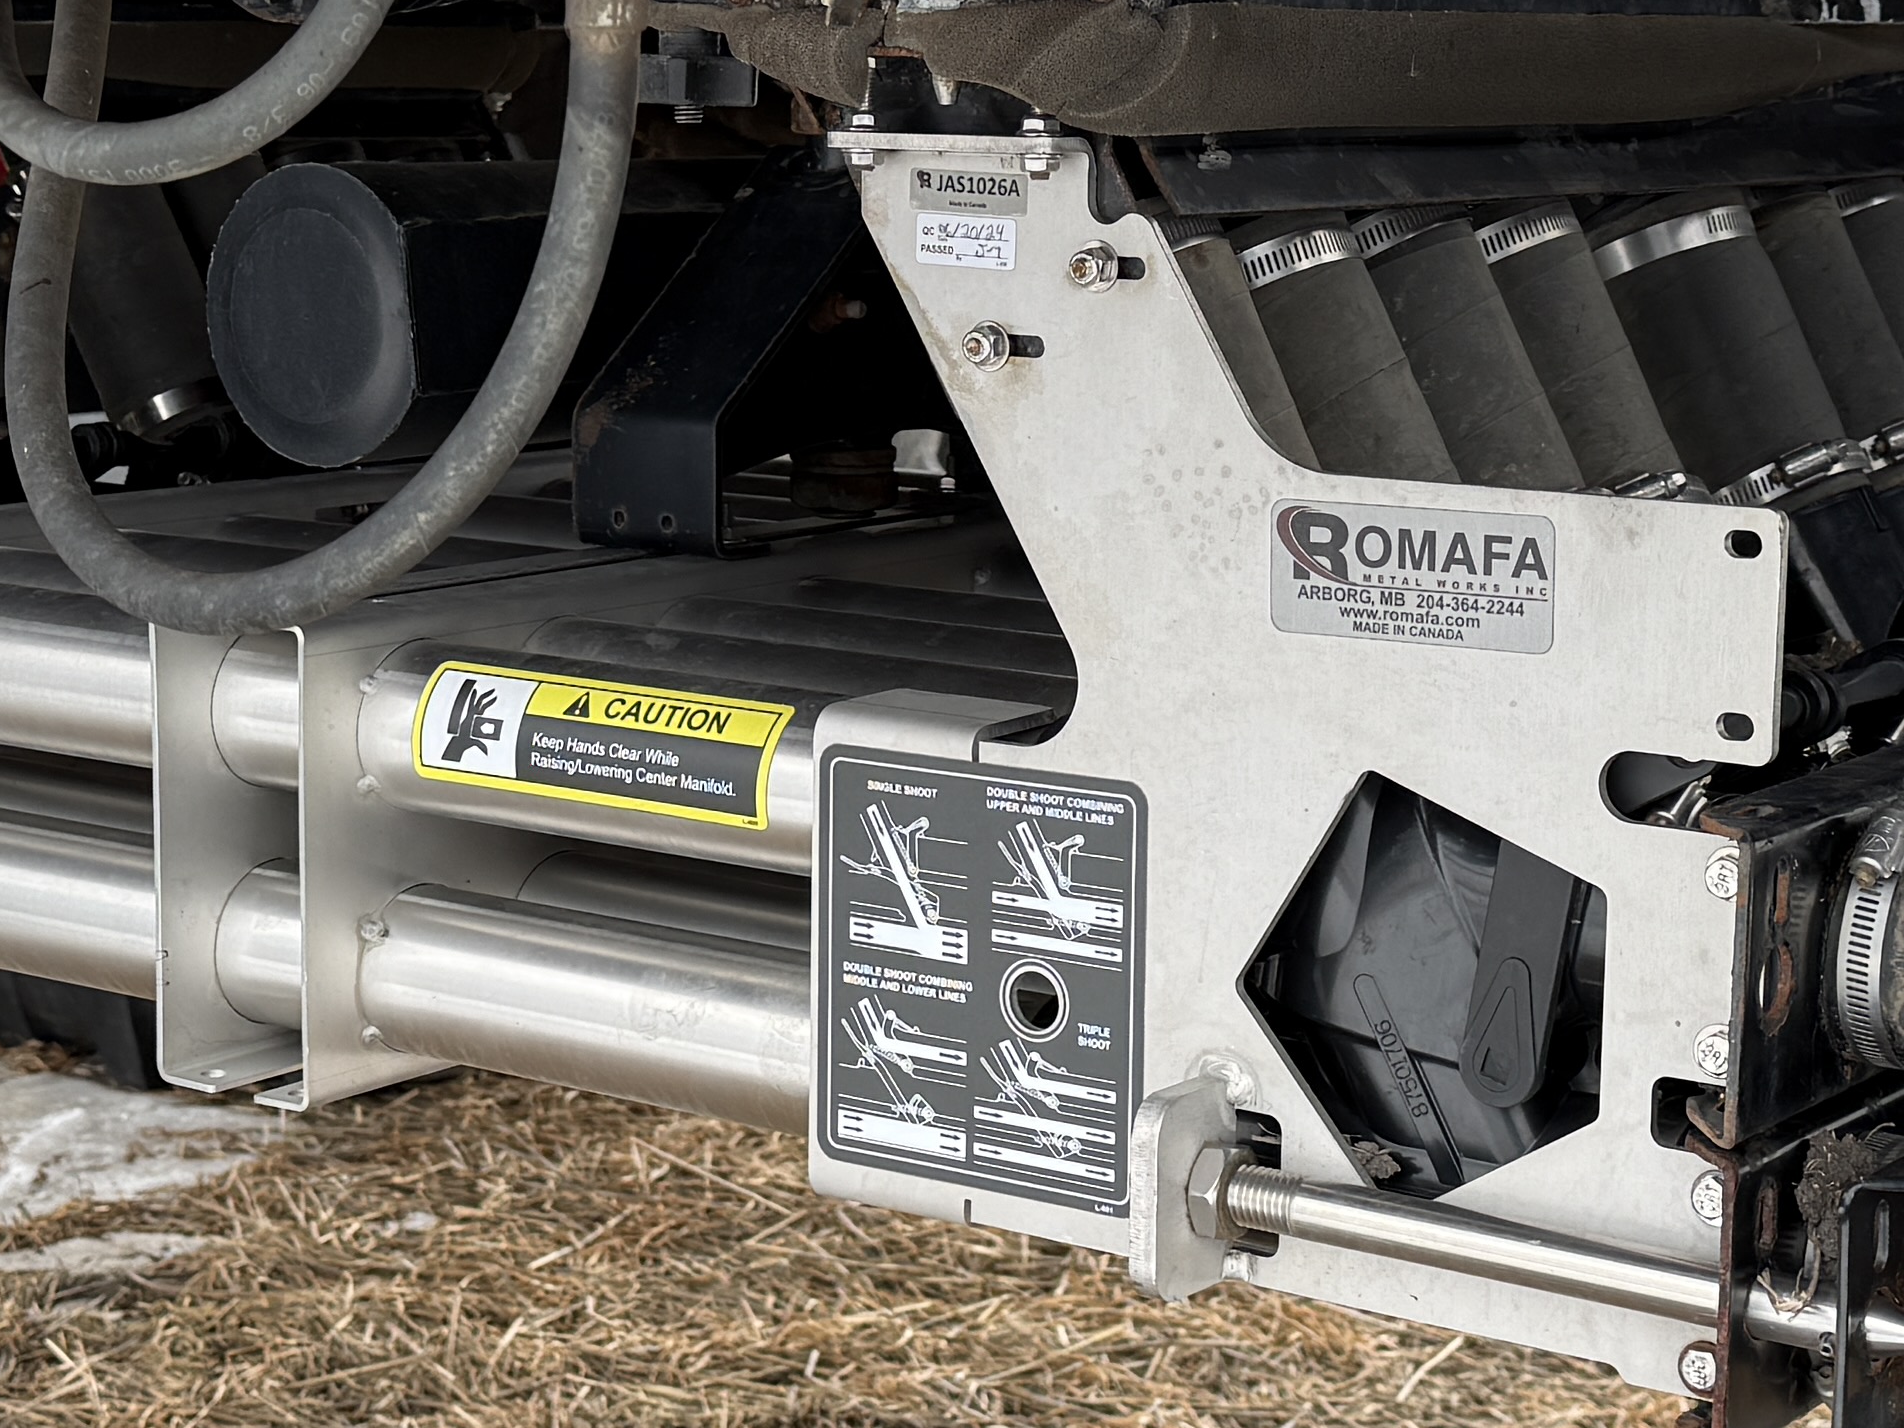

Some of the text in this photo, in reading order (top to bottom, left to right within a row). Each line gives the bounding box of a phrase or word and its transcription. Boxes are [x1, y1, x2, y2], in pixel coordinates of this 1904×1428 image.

[936, 174, 1020, 198] JAS1026A
[922, 227, 935, 236] QC
[920, 244, 954, 255] PASSED
[1276, 505, 1549, 582] ROMAFA
[1362, 573, 1548, 597] METAL WORKS INC
[1297, 584, 1525, 617] ARBORG, MB 204-364-2244
[1339, 606, 1481, 629] www.romafa.com
[1352, 620, 1464, 642] MADE IN CANADA
[603, 698, 733, 735] CAUTION
[531, 732, 680, 767] Keep Hands Clear While
[531, 752, 737, 798] Raising/Lowering Center Manifold.
[867, 779, 938, 799] SINGLE SHOOT
[986, 786, 1125, 814] DOUBLE SHOOT COMBINING
[986, 799, 1115, 826] UPPER AND MIDDLE LINES
[843, 961, 973, 992] DOUBLE SHOOT COMBINING
[843, 973, 967, 1003] MIDDLE AND LOWER LINES
[1077, 1022, 1111, 1038] TRIPLE
[1077, 1036, 1111, 1050] SHOOT
[1374, 1019, 1429, 1118] 87501706
